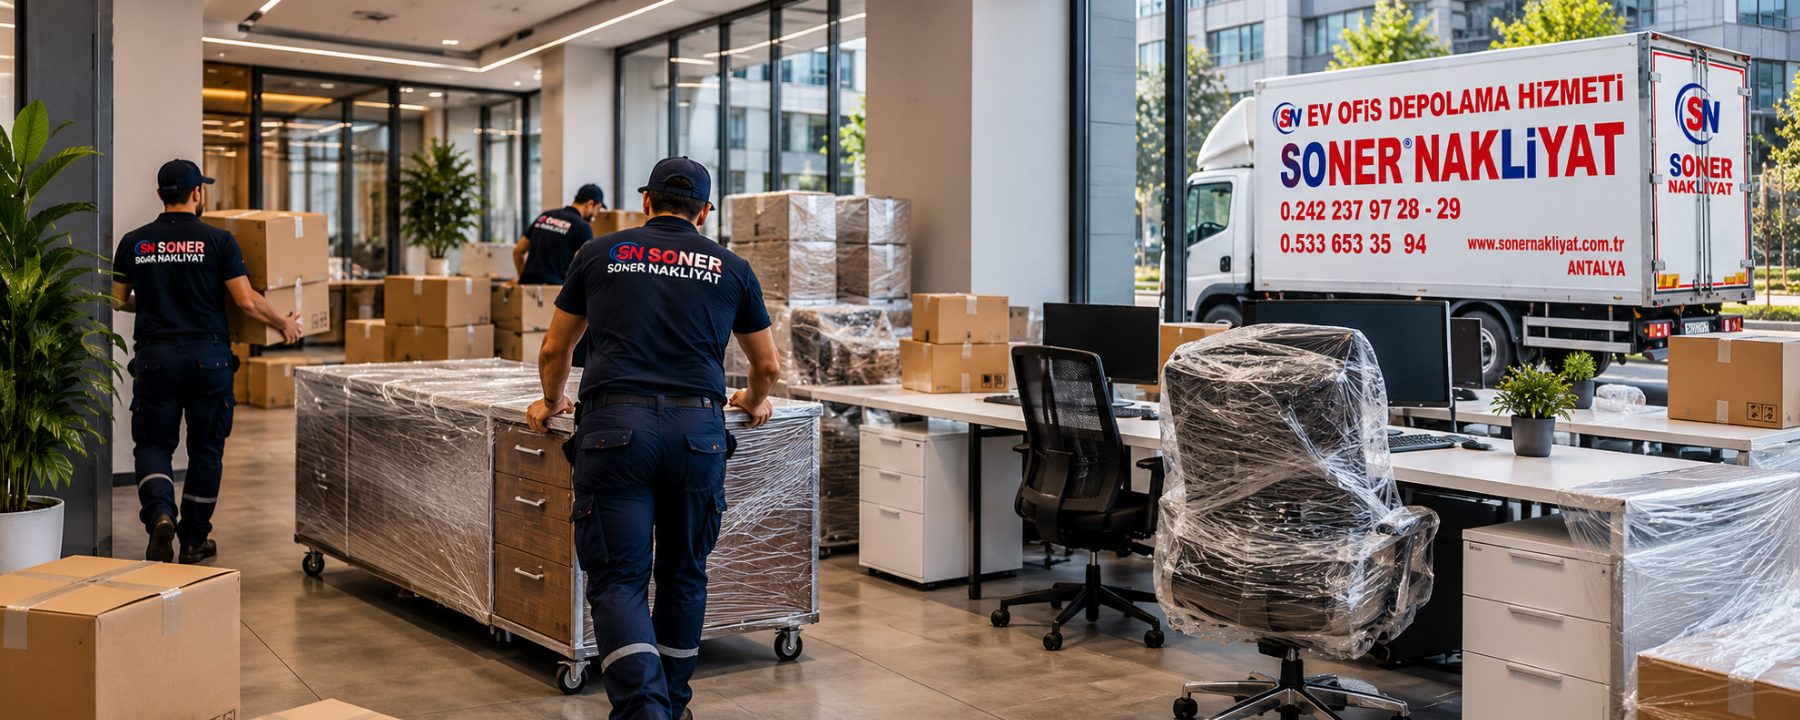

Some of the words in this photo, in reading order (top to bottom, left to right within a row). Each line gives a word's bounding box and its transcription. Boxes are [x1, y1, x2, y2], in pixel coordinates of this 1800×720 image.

[1307, 103, 1333, 127] EV
[1389, 85, 1510, 121] DEPOLAMA
[1669, 153, 1733, 179] SONER
[1280, 200, 1326, 221] 0.242
[1331, 200, 1363, 221] 237
[1369, 199, 1392, 220] 97
[1397, 198, 1420, 220] 28
[1437, 197, 1461, 220] 29
[157, 241, 205, 254] SONER
[1280, 233, 1326, 253] 0.533
[1331, 233, 1363, 254] 653
[1369, 233, 1392, 254] 35
[1404, 233, 1427, 255] 94
[1468, 235, 1625, 255] www.sonernakliyat.com.tr
[648, 247, 723, 274] SONER
[1567, 260, 1626, 277] ANTALYA
[607, 262, 646, 274] SONER
[648, 263, 722, 285] NAKLIYAT
